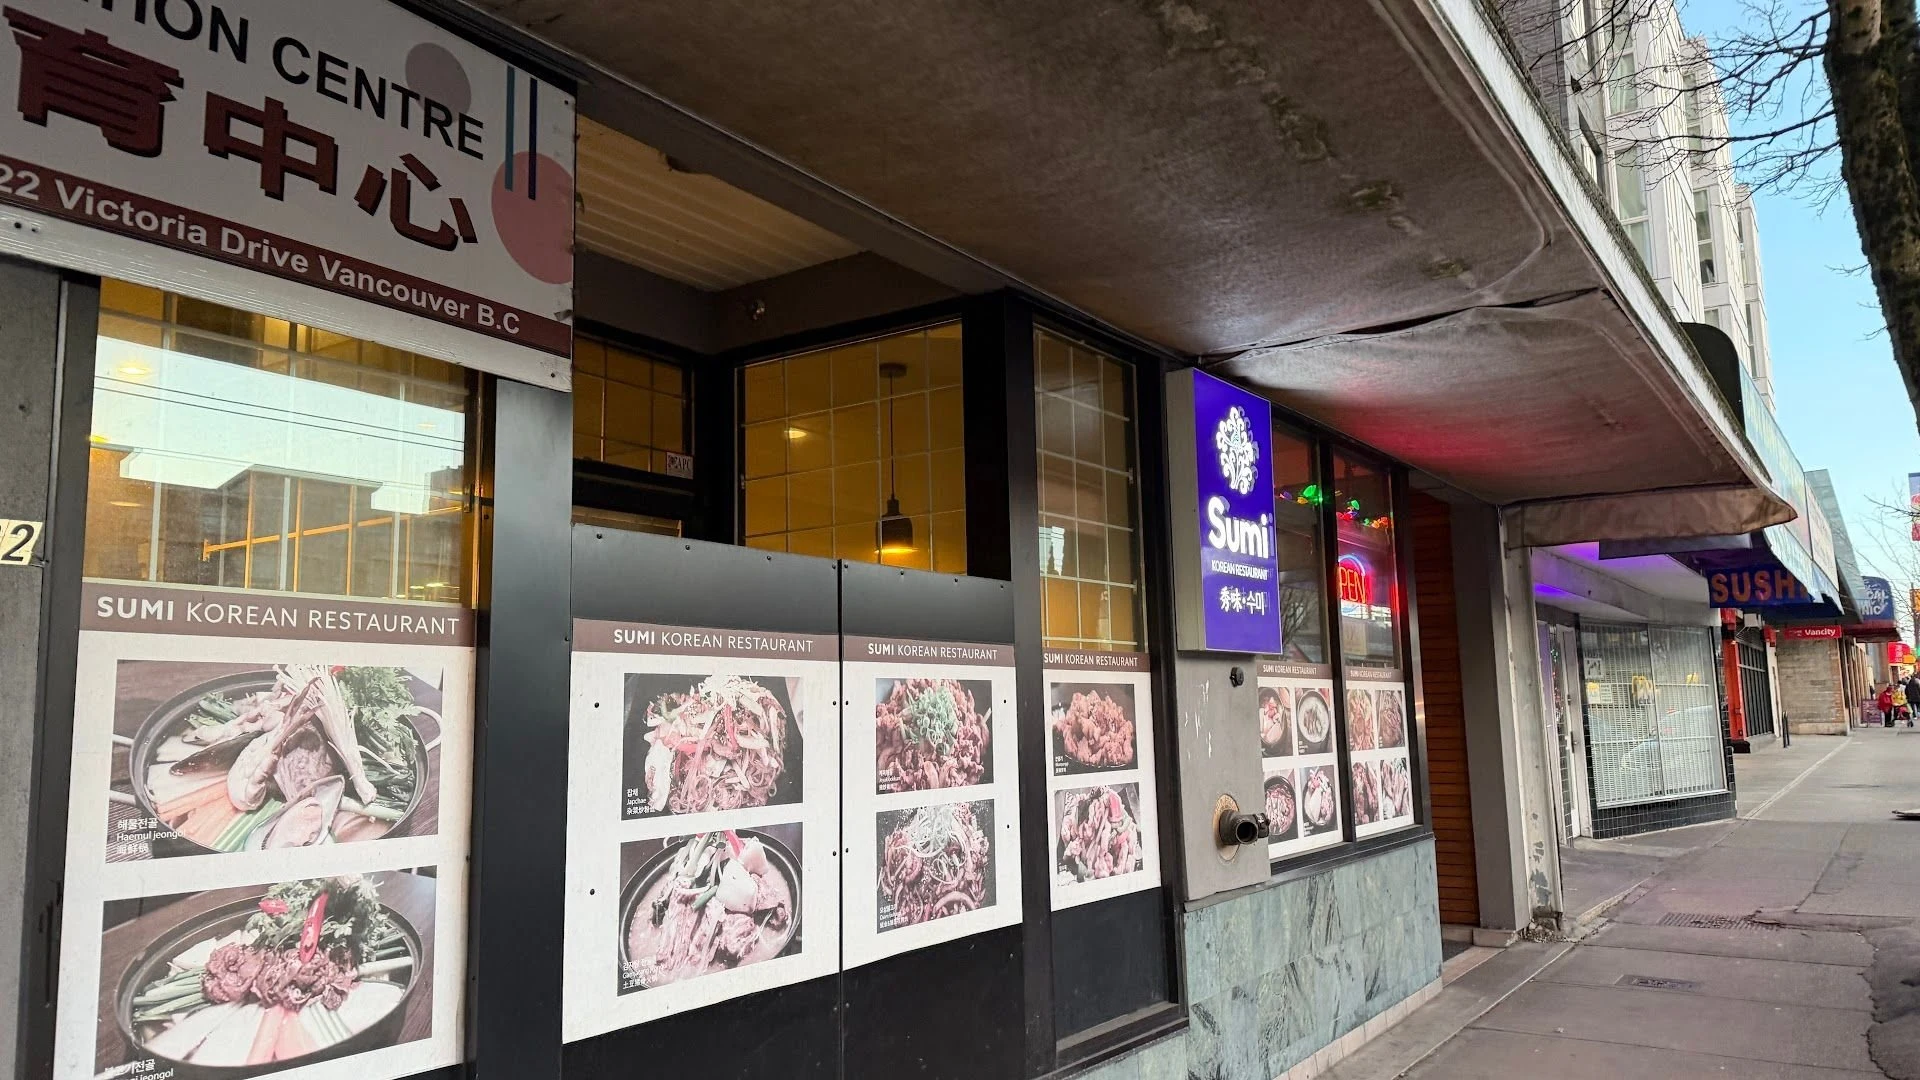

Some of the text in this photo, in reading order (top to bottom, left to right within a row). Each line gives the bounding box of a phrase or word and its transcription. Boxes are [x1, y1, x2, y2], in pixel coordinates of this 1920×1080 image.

[273, 36, 484, 161] CENTRE
[2, 5, 478, 252] 育中心
[54, 179, 207, 246] Victoria
[220, 227, 309, 273] Drive
[318, 255, 470, 319] Vancouver
[477, 303, 520, 334] B.C
[1207, 496, 1269, 558] Sumi
[0, 524, 35, 562] 2
[1211, 560, 1268, 580] KOREAN RESTAURANT
[1339, 567, 1366, 604] PEN
[97, 596, 460, 635] SUMI KOREAN RESTAURANT
[613, 629, 813, 653] SUMI KOREAN RESTAURANT
[1804, 628, 1836, 637] Vancity
[868, 643, 998, 660] SUMI KOREAN RESTAURANT
[1043, 652, 1138, 667] SUMI KOREAN RESTAURANT
[116, 830, 152, 841] Haemul
[117, 817, 159, 831] 해물전골
